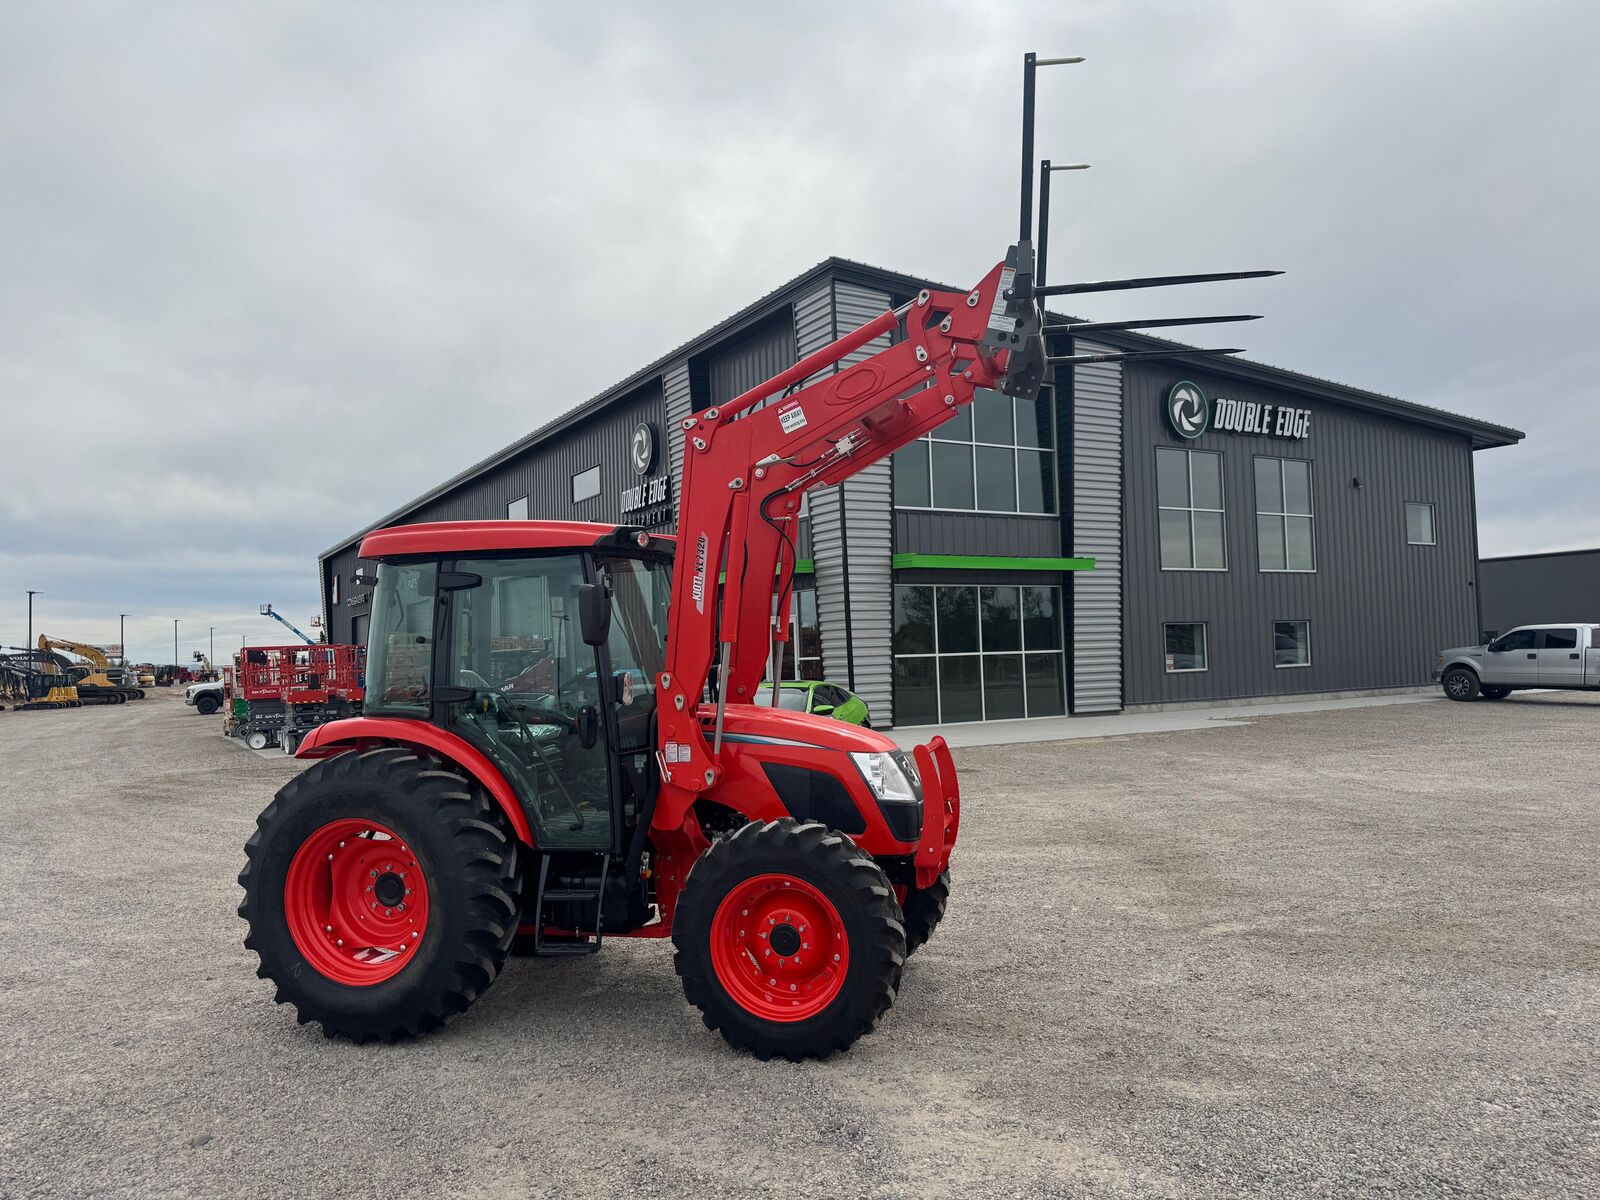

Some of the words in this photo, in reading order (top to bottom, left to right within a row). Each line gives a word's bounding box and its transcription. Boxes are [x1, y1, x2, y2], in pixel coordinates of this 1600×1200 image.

[781, 414, 791, 423] KEEP
[791, 409, 802, 419] AWAY
[1214, 398, 1272, 434] DOUBLE
[1275, 406, 1311, 439] EDGE
[621, 484, 647, 513] DOUBLE
[649, 476, 668, 504] EDGE
[695, 536, 706, 573] KL7320
[692, 575, 703, 601] KIOTI
